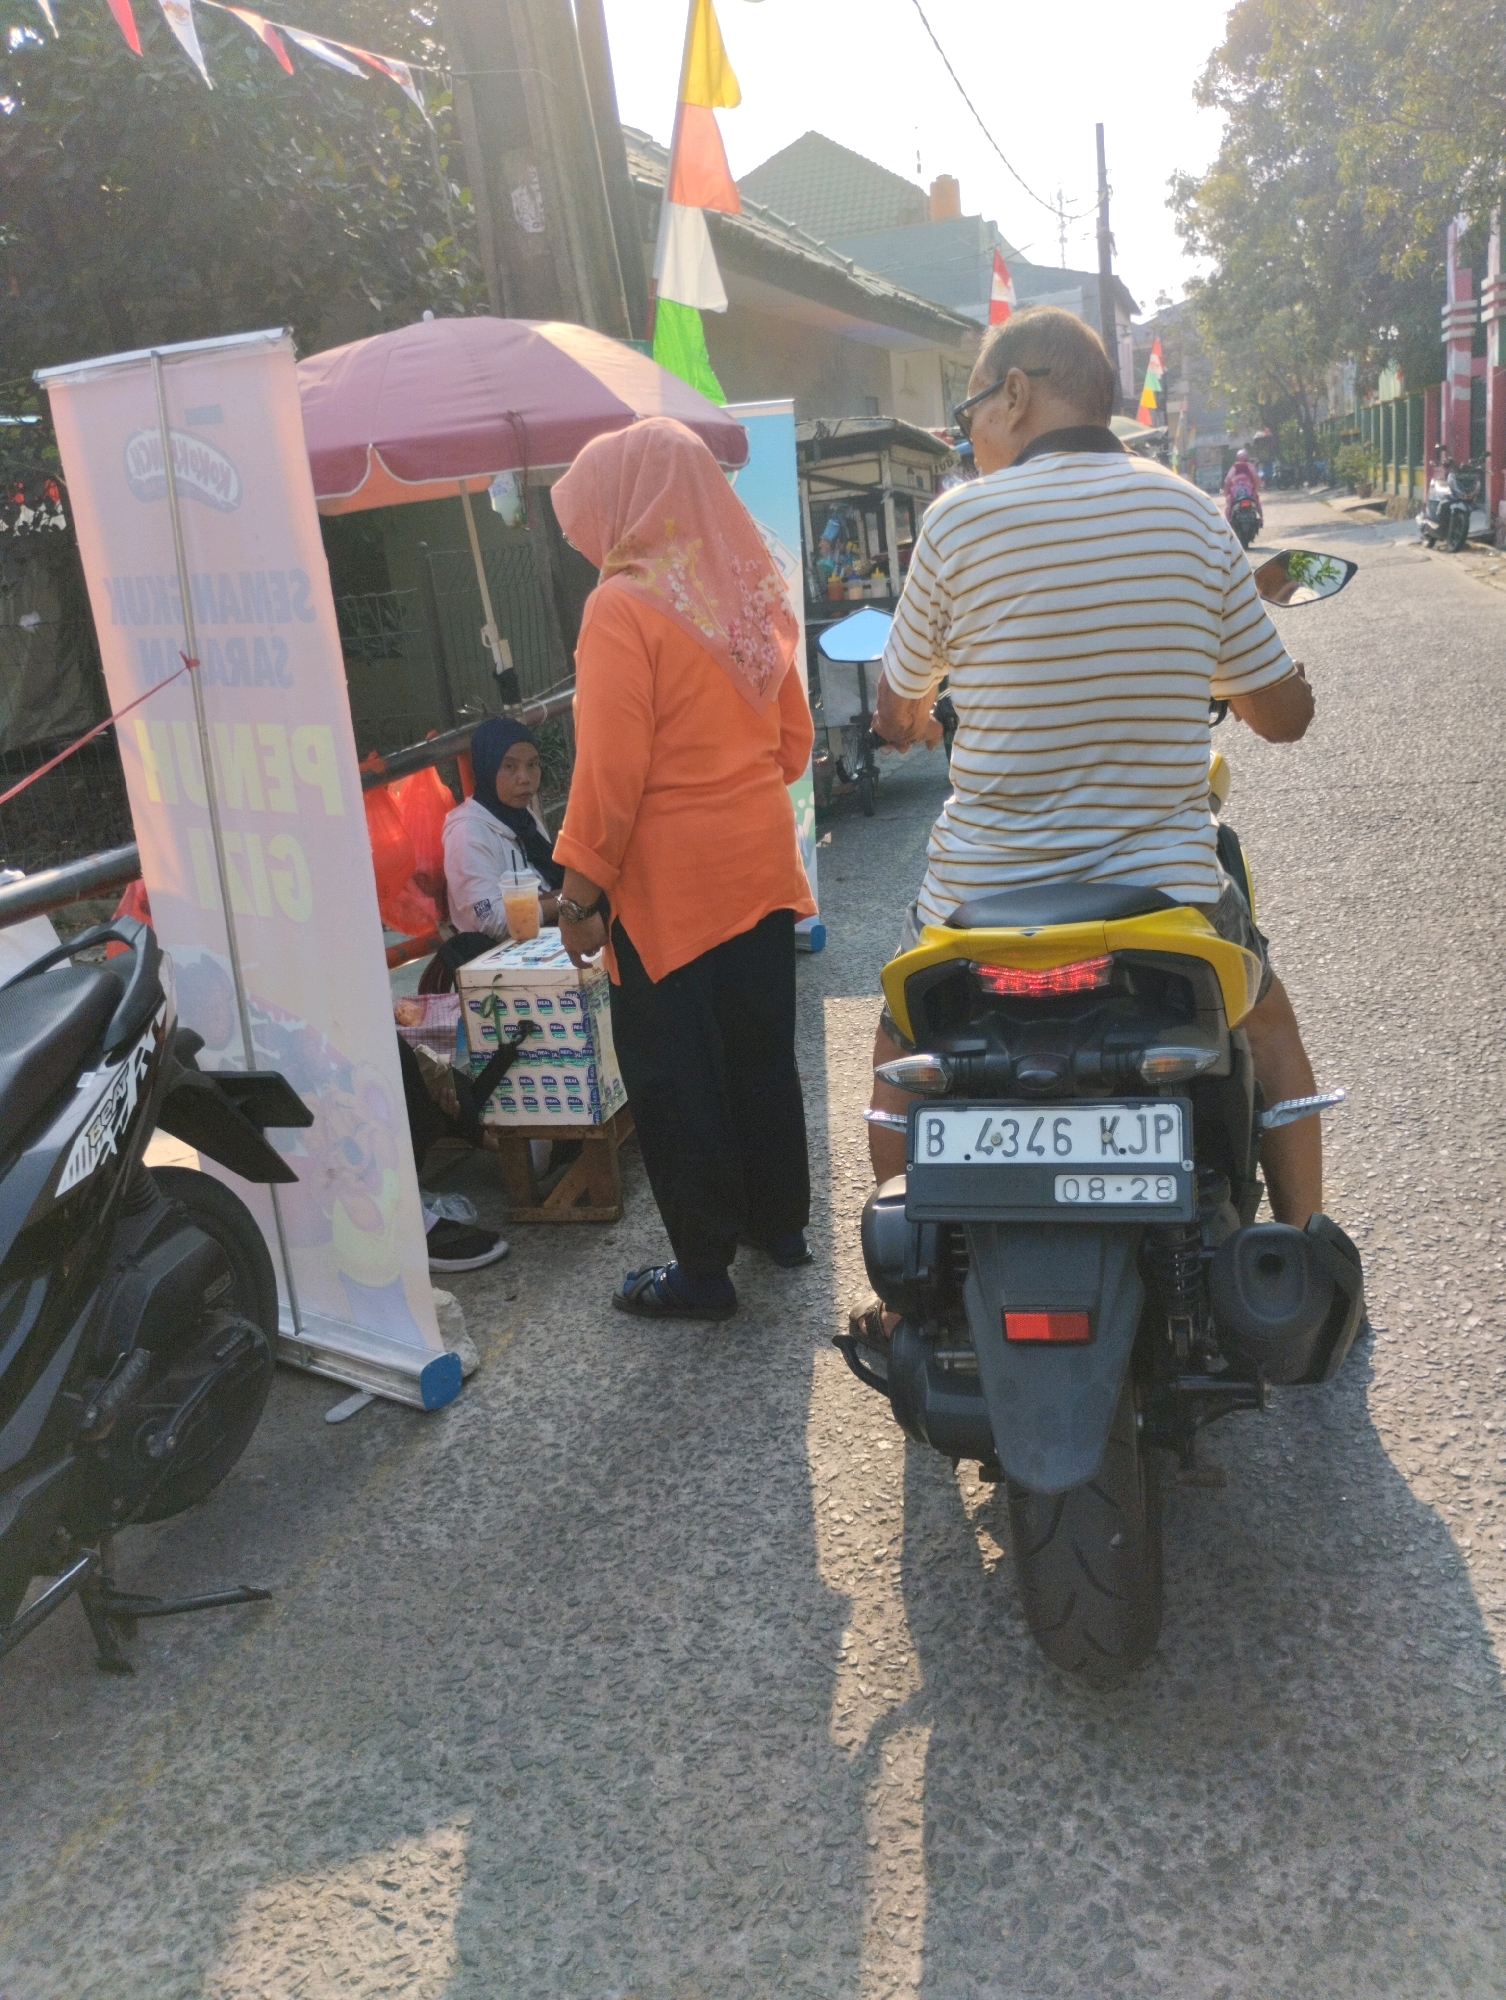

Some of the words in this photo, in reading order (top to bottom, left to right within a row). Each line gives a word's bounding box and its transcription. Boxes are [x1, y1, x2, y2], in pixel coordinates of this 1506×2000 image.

[926, 1118, 945, 1157] B
[974, 1116, 1073, 1157] 4346
[1100, 1113, 1174, 1156] KJP
